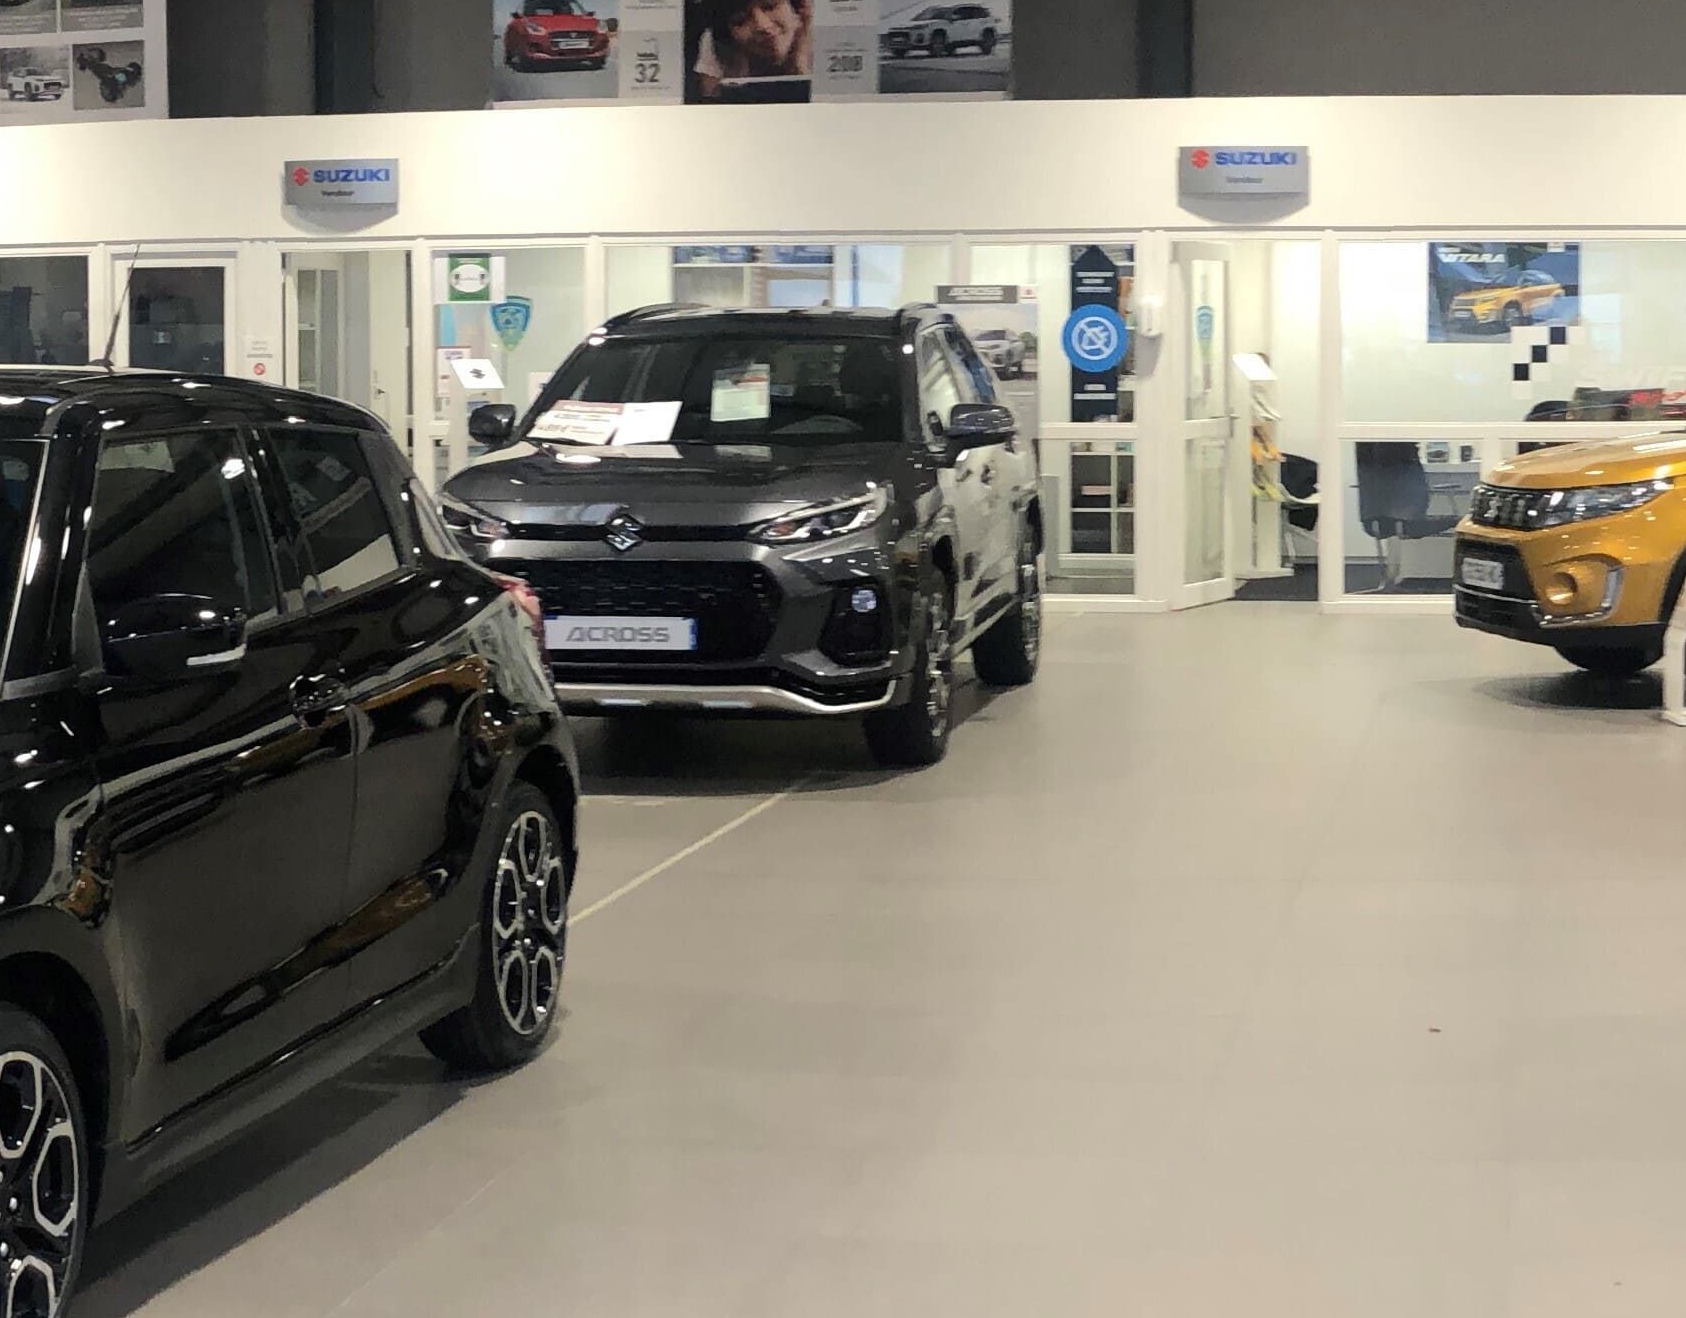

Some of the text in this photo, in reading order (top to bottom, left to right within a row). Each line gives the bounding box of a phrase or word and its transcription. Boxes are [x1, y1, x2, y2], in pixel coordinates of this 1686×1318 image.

[634, 63, 660, 83] 32
[1214, 151, 1297, 165] SUZUKI
[313, 168, 390, 183] SUZUKI
[566, 626, 670, 643] ACROSS
